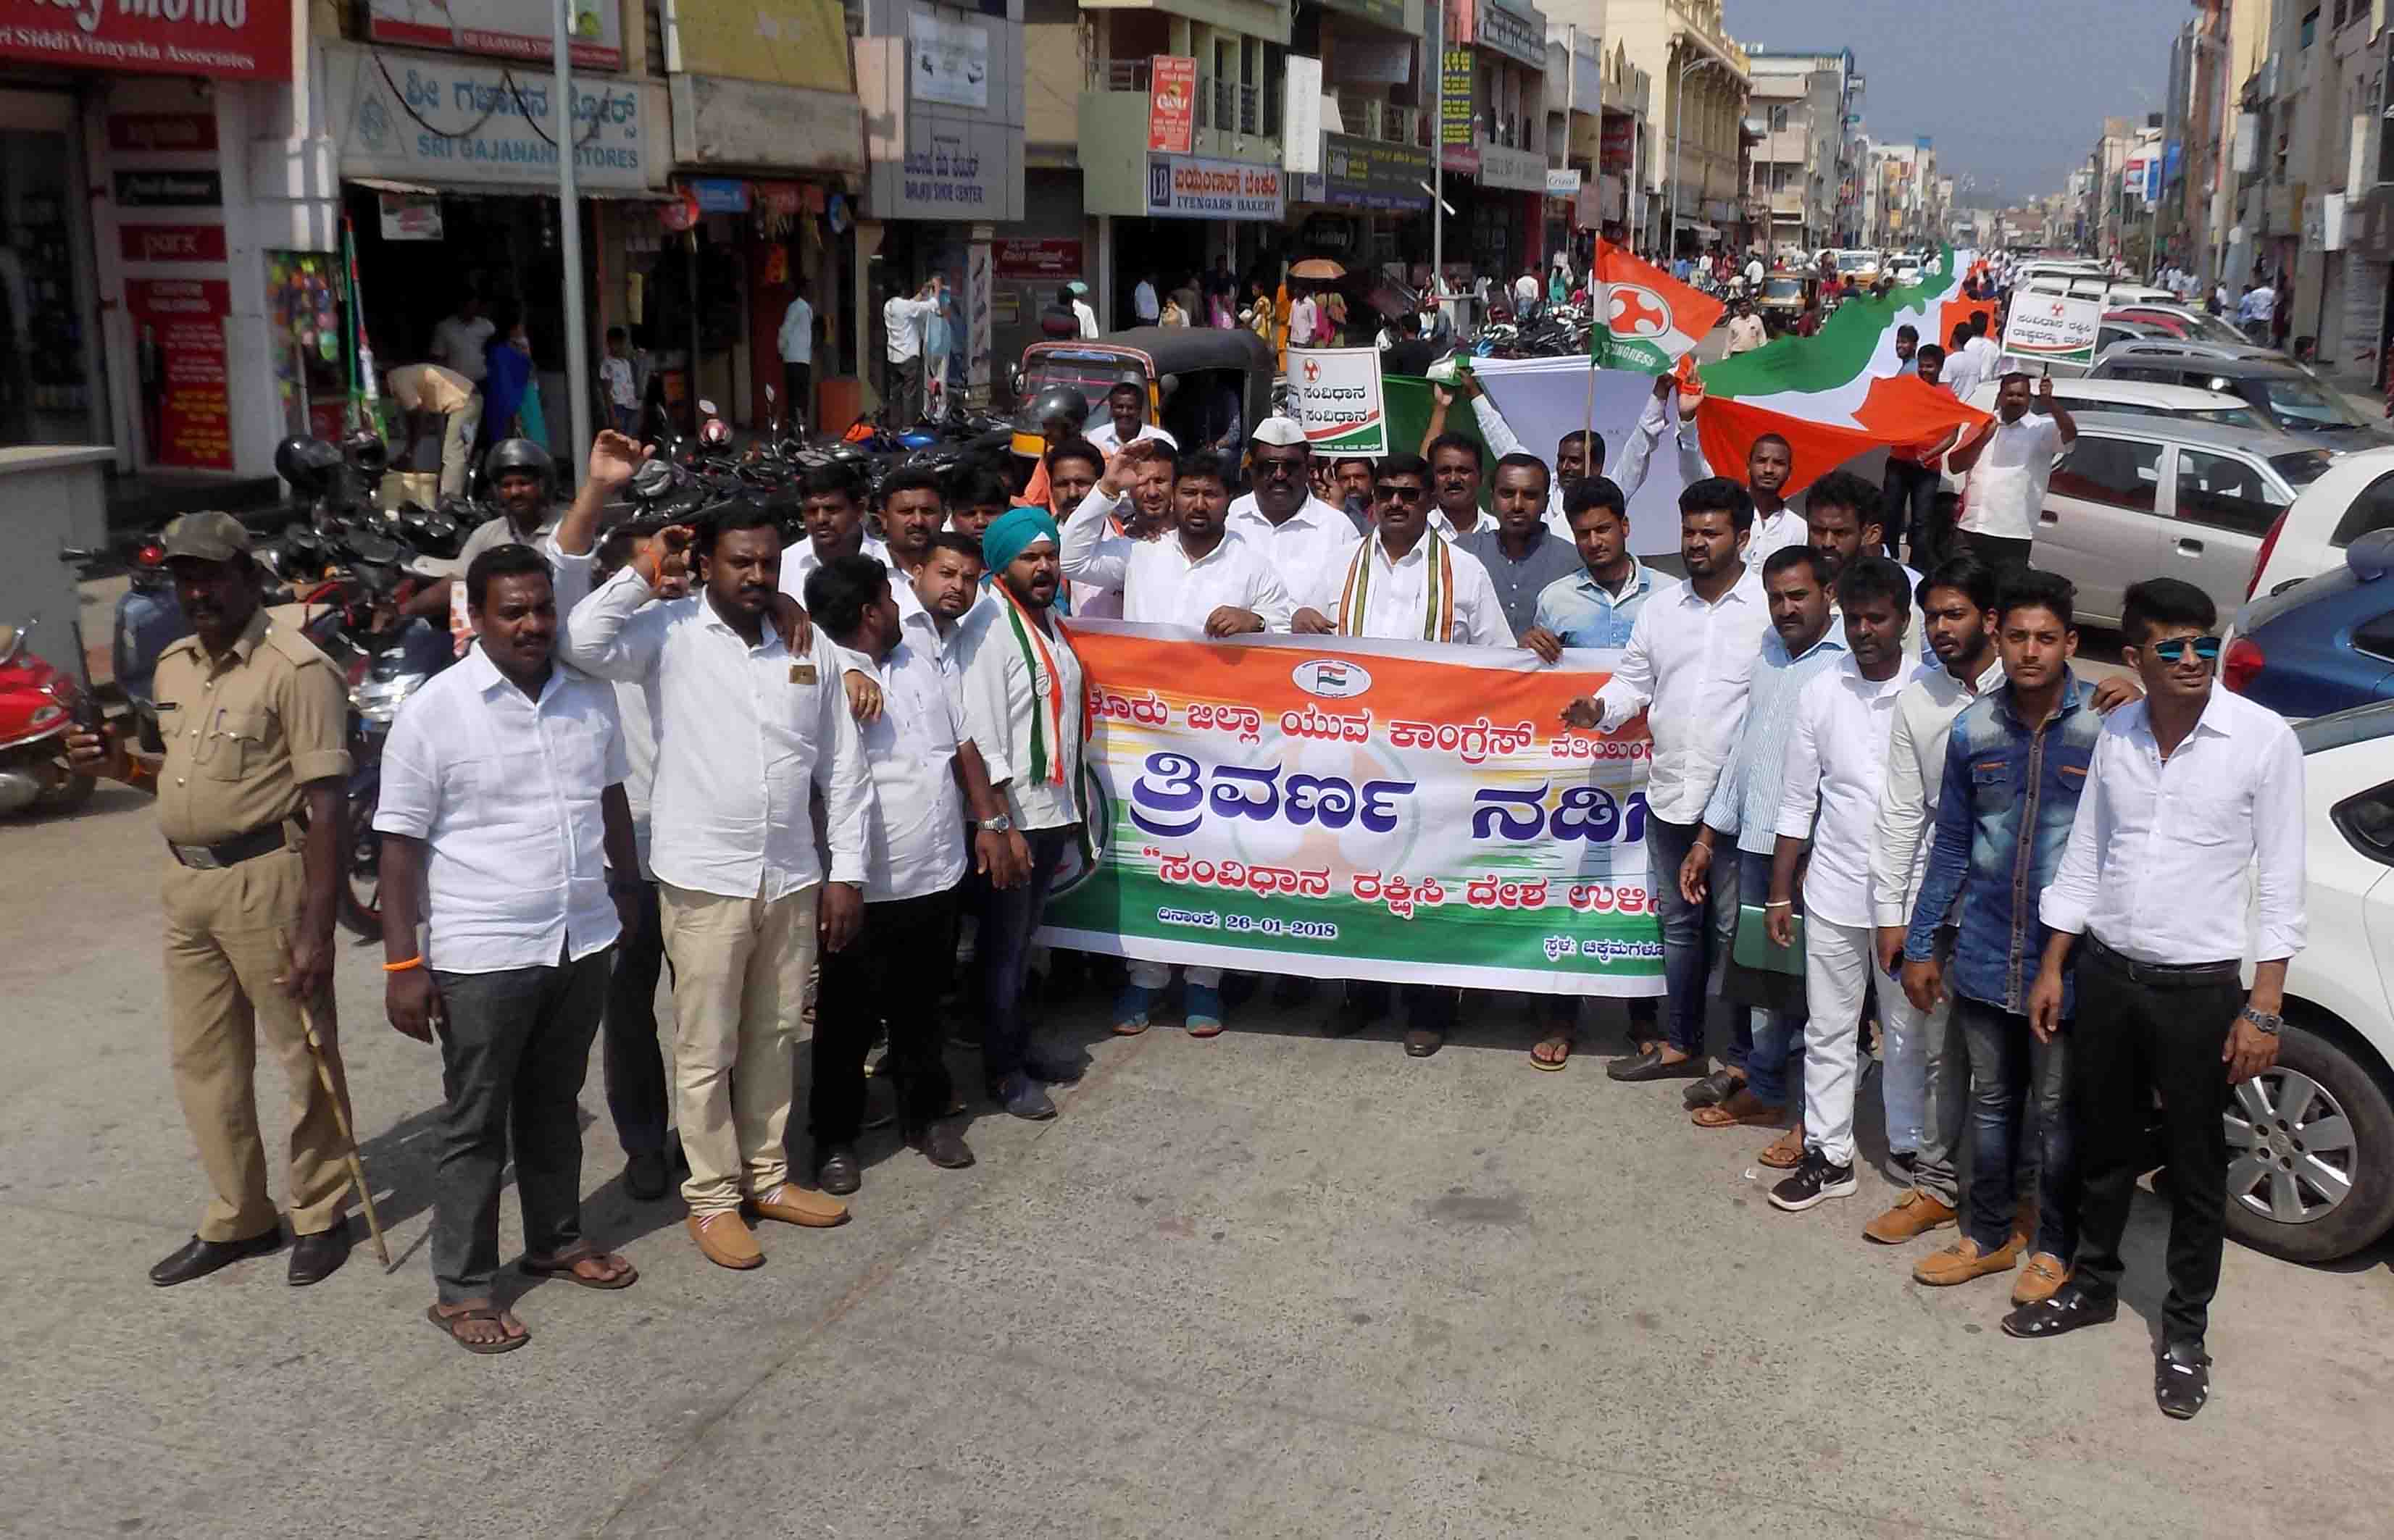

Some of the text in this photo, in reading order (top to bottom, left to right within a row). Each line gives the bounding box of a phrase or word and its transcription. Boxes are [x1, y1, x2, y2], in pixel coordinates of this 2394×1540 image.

[17, 30, 70, 51] Siddi
[71, 34, 159, 62] Vinayaka
[167, 43, 256, 70] Associates
[417, 135, 638, 169] SRI GAJANAN STORES
[1304, 385, 1366, 403] ಸಂವಿಧಾನ
[1306, 408, 1368, 424] ಸಂವಿಧಾನ
[1187, 703, 1261, 745] ಜಿಲ್ಲಾ
[1280, 703, 1371, 743] ಯುವ
[1389, 717, 1534, 764] ಕಾಂಗ್ರೆಸ್
[1129, 752, 1418, 837] ತ್ರಿವರ್ಣ
[1352, 871, 1445, 921] ರಕ್ಷಿಸಿ
[1466, 874, 1548, 908] ದೇಶ
[1158, 907, 1337, 937] ದಿನಾಂಕ: 26-01-2018
[1582, 940, 1664, 963] ಚಿಕ್ಕಮಗಳೂ
